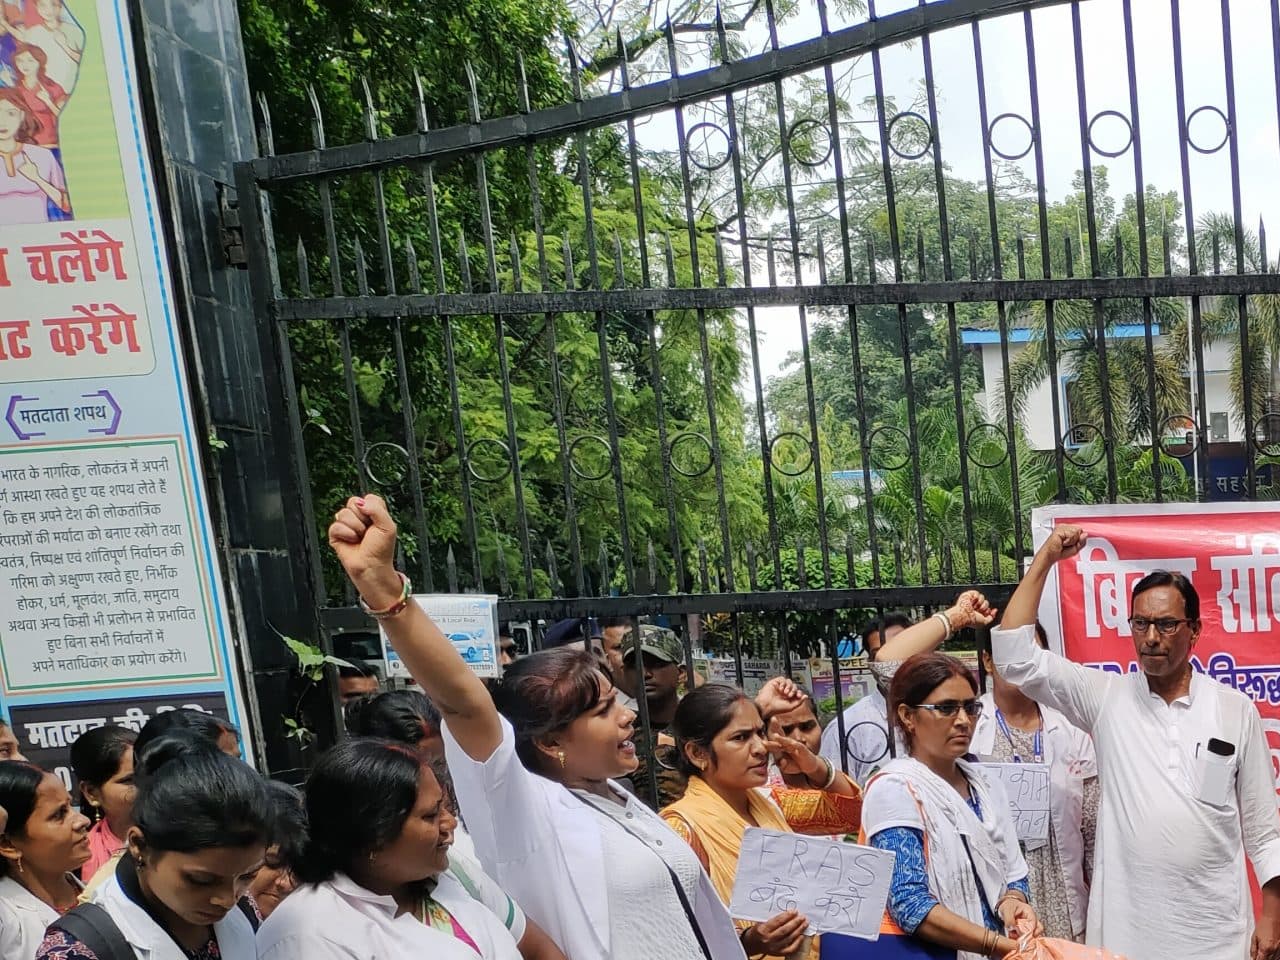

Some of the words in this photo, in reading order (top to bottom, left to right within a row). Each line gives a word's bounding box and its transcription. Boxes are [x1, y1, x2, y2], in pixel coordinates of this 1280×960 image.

[22, 230, 127, 285] चलेंगे
[43, 303, 141, 357] करेंगे
[20, 405, 69, 425] मतदाता
[74, 403, 107, 423] शपथ
[1, 468, 26, 482] भारत
[29, 465, 39, 479] के
[86, 460, 127, 476] लोकतंत्र
[131, 458, 139, 473] में
[142, 457, 169, 472] अपनी
[11, 489, 41, 502] आस्था
[45, 485, 68, 500] रखते
[72, 486, 87, 501] हुए
[90, 486, 105, 498] यह
[109, 483, 135, 497] शपथ
[137, 480, 156, 494] लेते
[3, 510, 17, 525] कि
[21, 511, 36, 524] हम
[40, 507, 61, 522] अपने
[65, 506, 83, 521] देश
[86, 504, 100, 519] की
[103, 501, 161, 519] लोकतांत्रिक
[36, 529, 50, 545] की
[54, 528, 85, 543] मर्यादा
[86, 527, 102, 541] को
[105, 527, 131, 541] बनाए
[134, 524, 157, 538] रखेंगे
[160, 523, 182, 537] तथा
[30, 551, 65, 568] निष्पक्ष
[67, 548, 83, 564] एवं
[85, 544, 128, 564] शांतिपूर्ण
[130, 545, 169, 560] निर्वाचन
[171, 543, 185, 557] की
[9, 574, 38, 590] गरिमा
[41, 572, 55, 587] को
[59, 574, 94, 590] अक्षुण्ण
[97, 570, 122, 583] रखते
[124, 569, 143, 585] हुए,
[145, 565, 178, 581] निर्भीक
[16, 595, 47, 611] होकर,
[50, 593, 69, 609] धर्म,
[71, 592, 110, 610] मूलवंश,
[113, 588, 141, 604] जाति,
[143, 588, 179, 604] समुदाय
[8, 617, 37, 632] अथवा
[40, 616, 60, 629] अन्य
[64, 611, 90, 629] किसी
[93, 611, 105, 625] भी
[107, 610, 143, 625] प्रलोभन
[146, 608, 154, 623] से
[158, 606, 197, 622] प्रभावित
[46, 637, 61, 653] हुए
[64, 635, 87, 649] बिना
[90, 632, 110, 648] सभी
[113, 629, 154, 647] निर्वाचनों
[157, 628, 165, 643] में
[32, 658, 55, 673] अपने
[58, 655, 108, 672] मताधिकार
[111, 654, 126, 667] का
[128, 651, 156, 667] प्रयोग
[159, 648, 187, 665] करेंगे।
[759, 833, 881, 887] FRAS
[750, 878, 798, 913] बंद
[815, 885, 866, 928] करो
